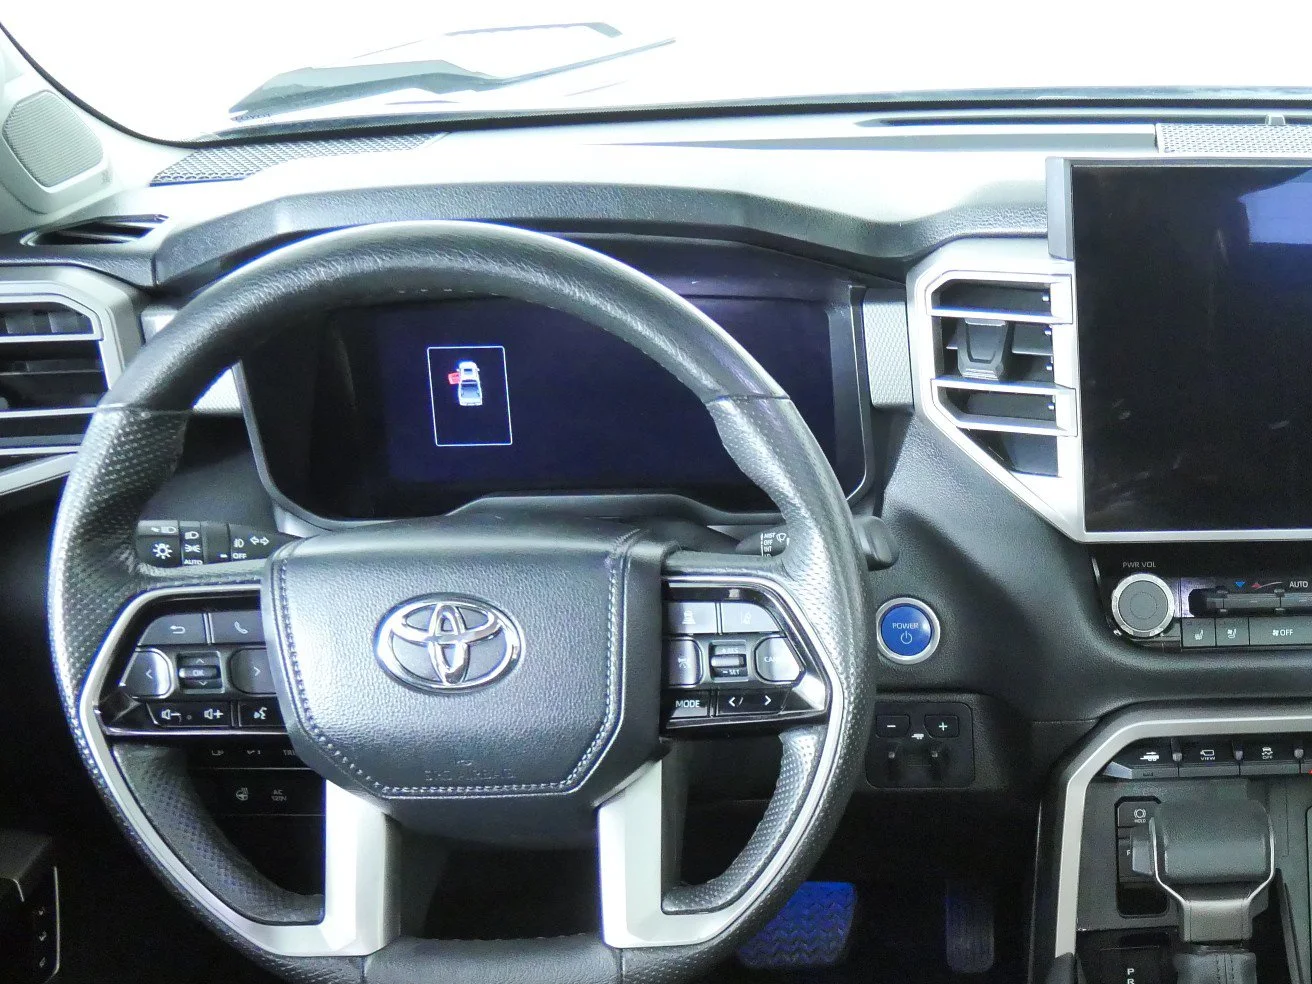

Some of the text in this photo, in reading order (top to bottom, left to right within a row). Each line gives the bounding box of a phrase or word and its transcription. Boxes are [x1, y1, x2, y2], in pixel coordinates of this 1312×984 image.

[232, 552, 248, 560] OFF
[1289, 580, 1309, 588] AUTO
[892, 622, 919, 630] POWER
[1279, 629, 1294, 637] OFF
[675, 700, 701, 708] MODE
[1127, 968, 1135, 976] P
